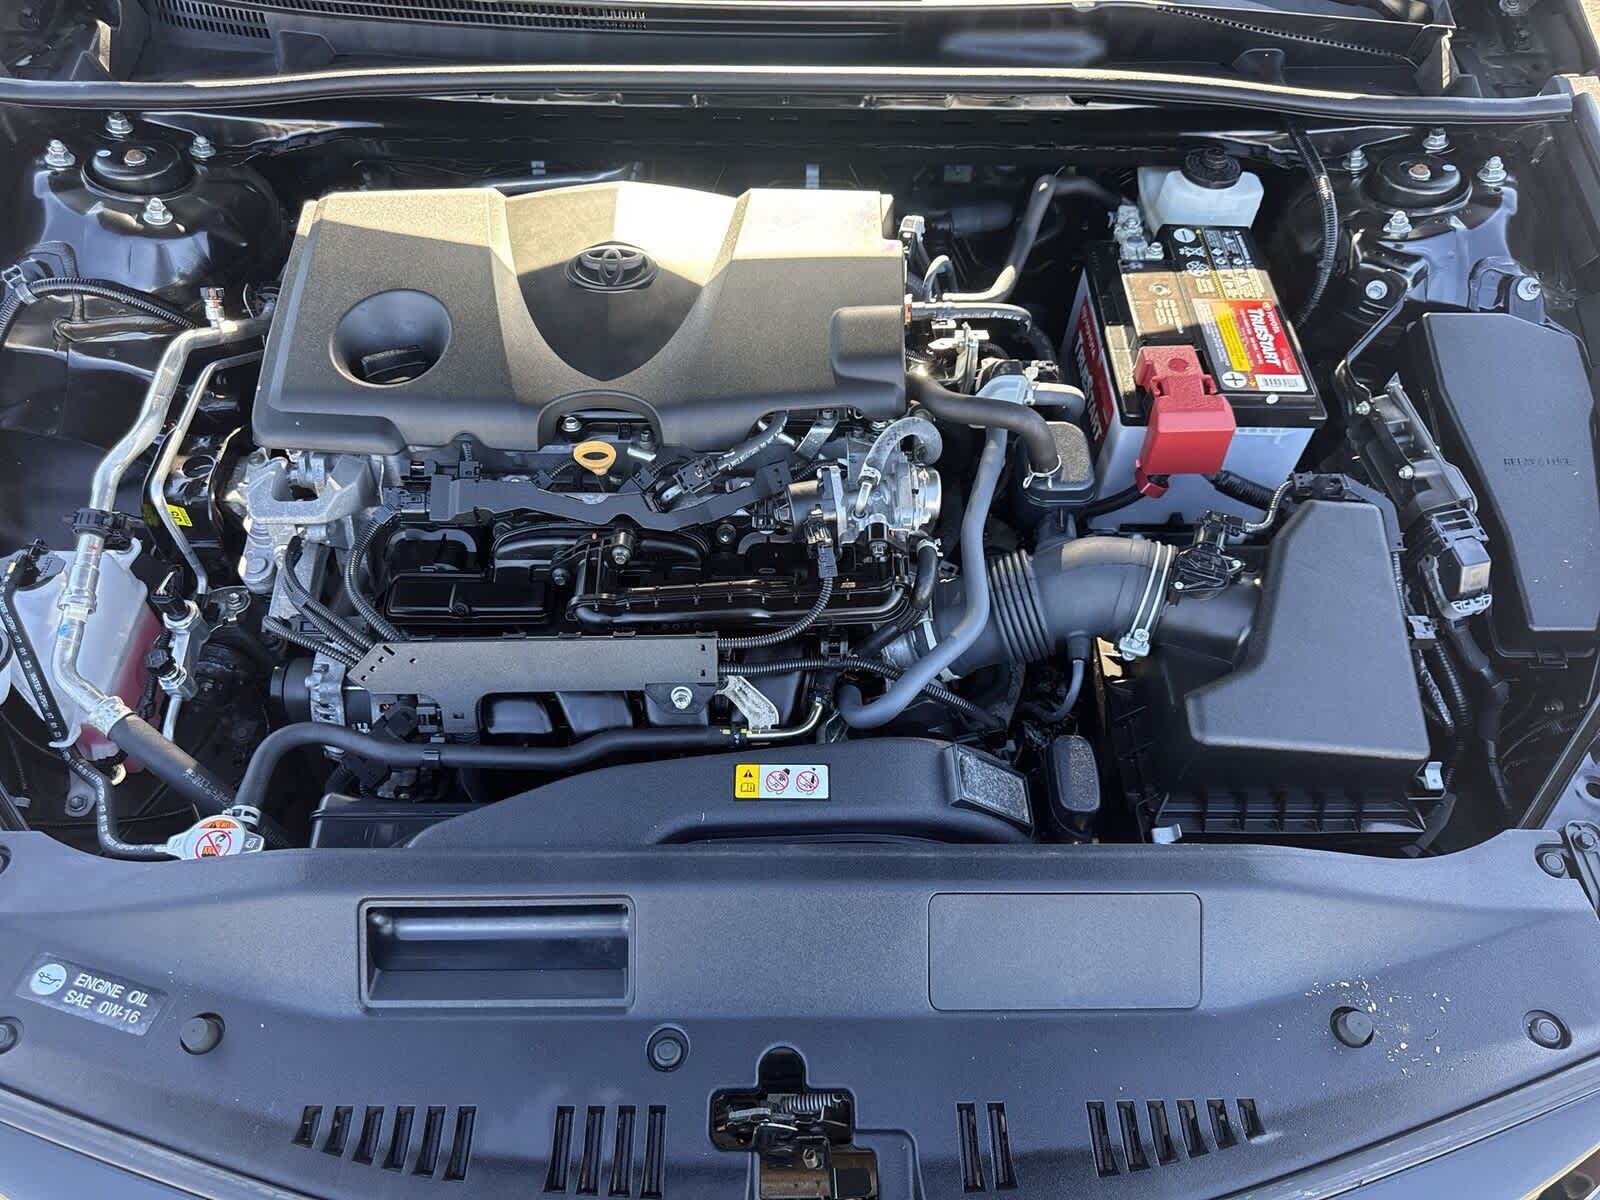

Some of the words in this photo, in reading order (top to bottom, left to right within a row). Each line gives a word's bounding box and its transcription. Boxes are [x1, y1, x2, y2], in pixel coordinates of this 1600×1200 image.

[1247, 308, 1281, 369] TRUESTART
[1266, 311, 1281, 333] TOYOTA
[63, 990, 95, 1009] SAE
[97, 1000, 141, 1024] 0W-16
[73, 973, 125, 998] ENGINE
[126, 990, 150, 1008] OIL
